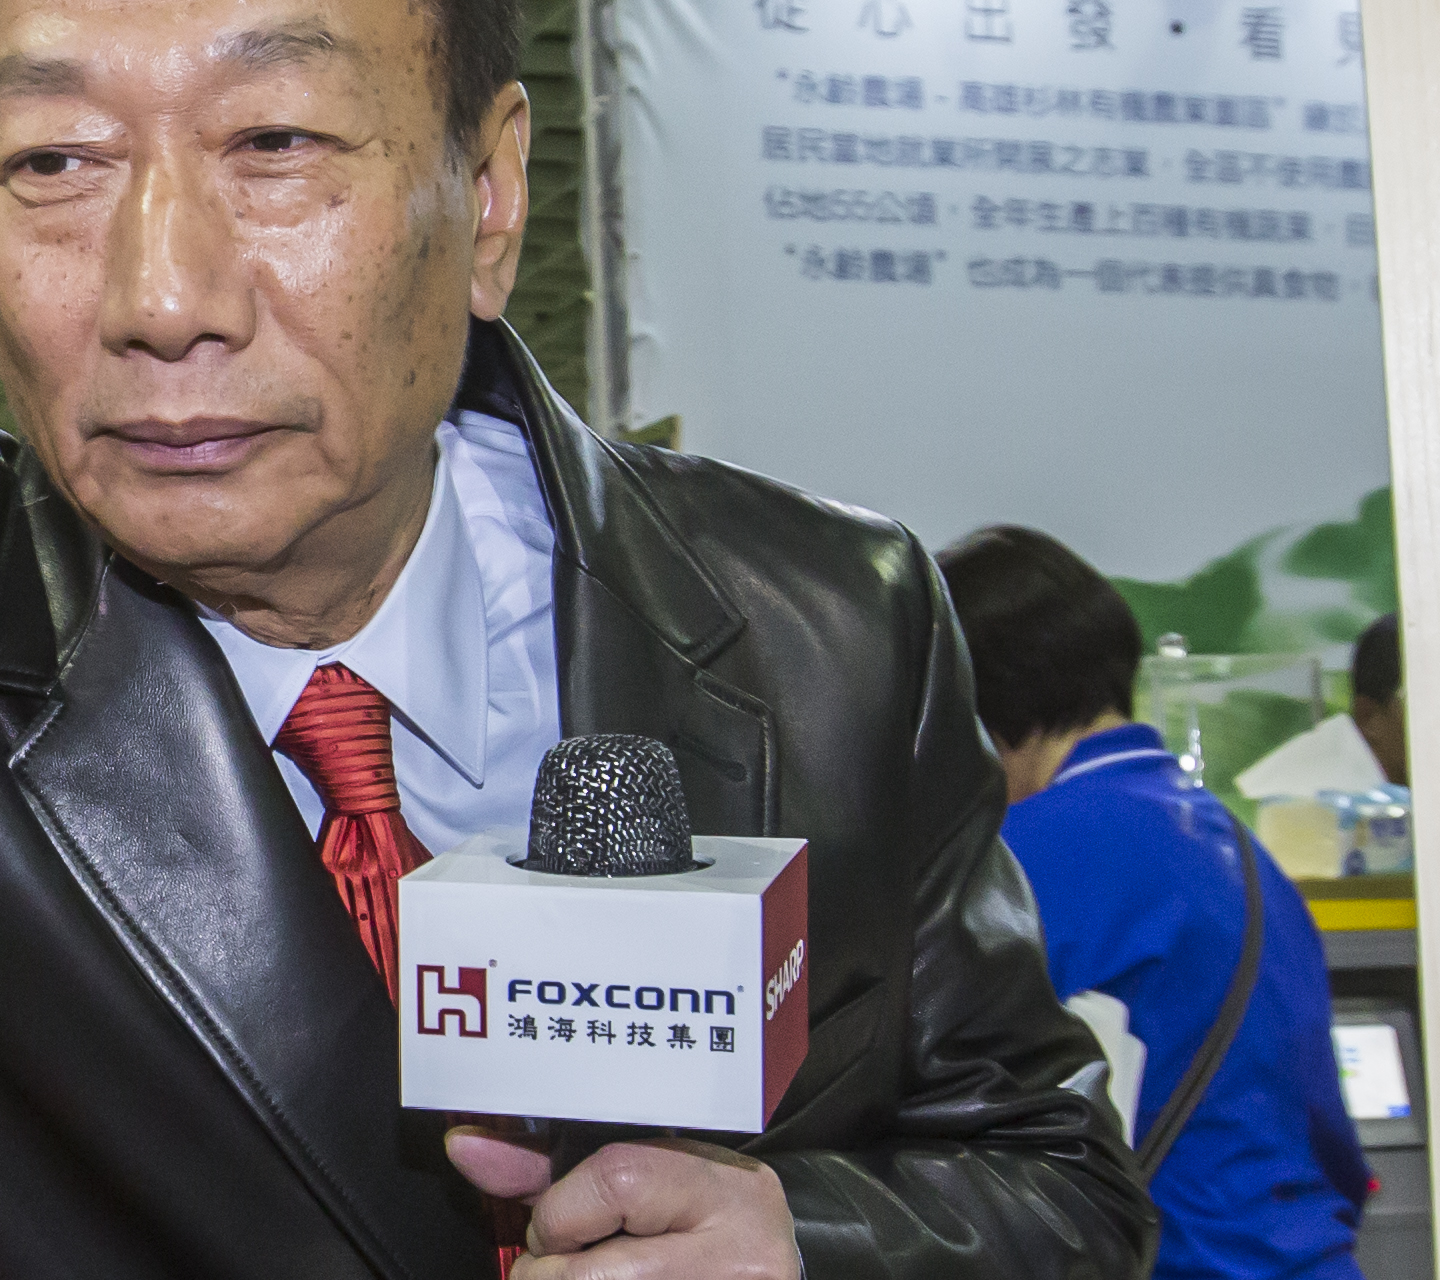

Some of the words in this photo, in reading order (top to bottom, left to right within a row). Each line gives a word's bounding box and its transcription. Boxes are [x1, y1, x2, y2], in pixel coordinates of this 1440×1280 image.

[765, 939, 806, 1020] SHARP
[507, 1014, 736, 1054] 鴻海科技集團
